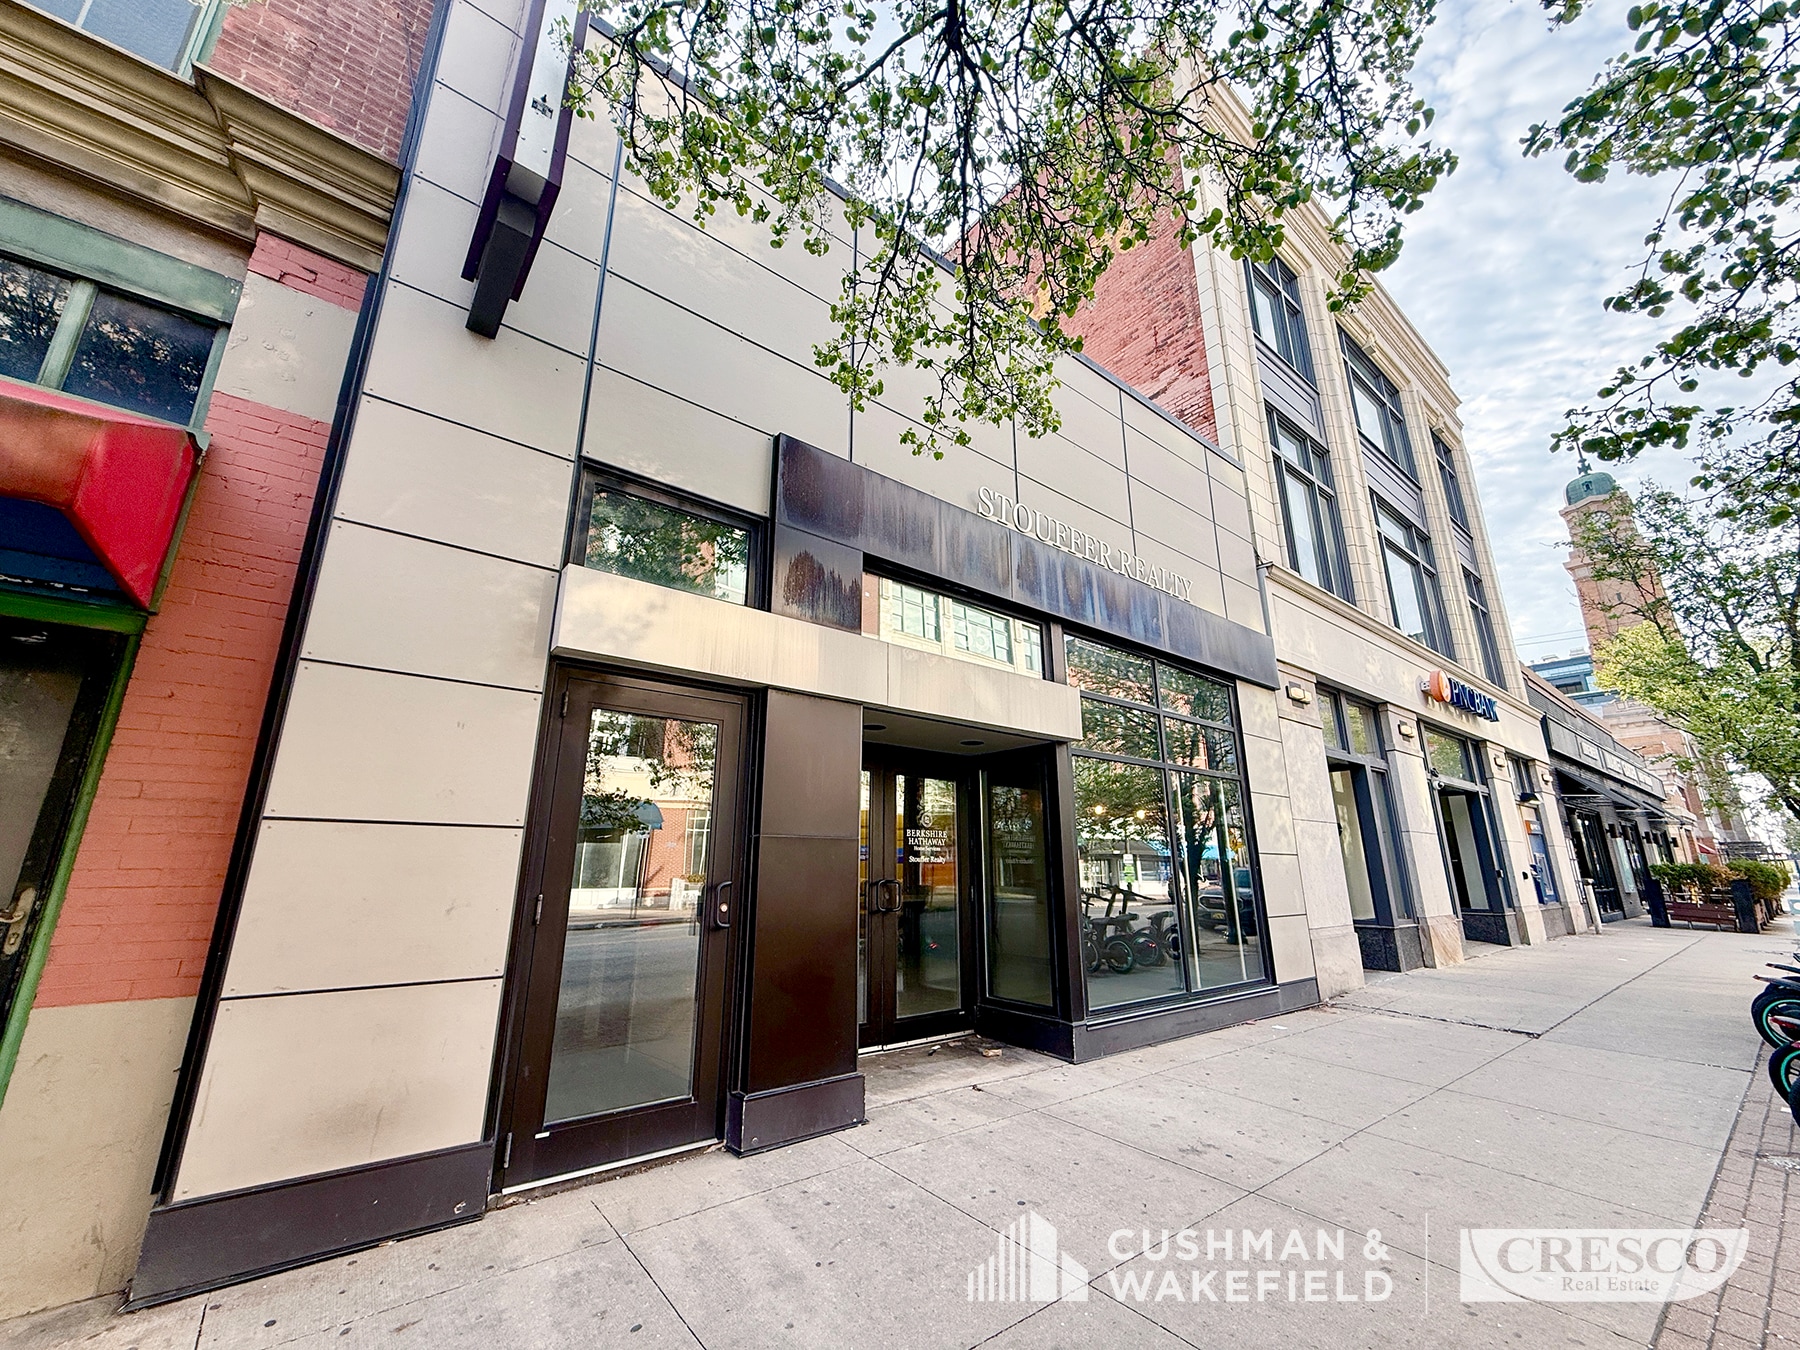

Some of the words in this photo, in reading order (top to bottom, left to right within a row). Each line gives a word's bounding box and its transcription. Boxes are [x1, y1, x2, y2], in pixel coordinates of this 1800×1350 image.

[977, 486, 1114, 571] STOUFFER
[1117, 548, 1194, 602] REALTY
[1449, 677, 1476, 712] PNC
[1474, 691, 1499, 722] BANK
[906, 829, 948, 838] BERKSHIRE
[908, 838, 947, 846] HATHAWAY
[908, 855, 930, 863] Stouffer
[930, 855, 946, 865] Realty
